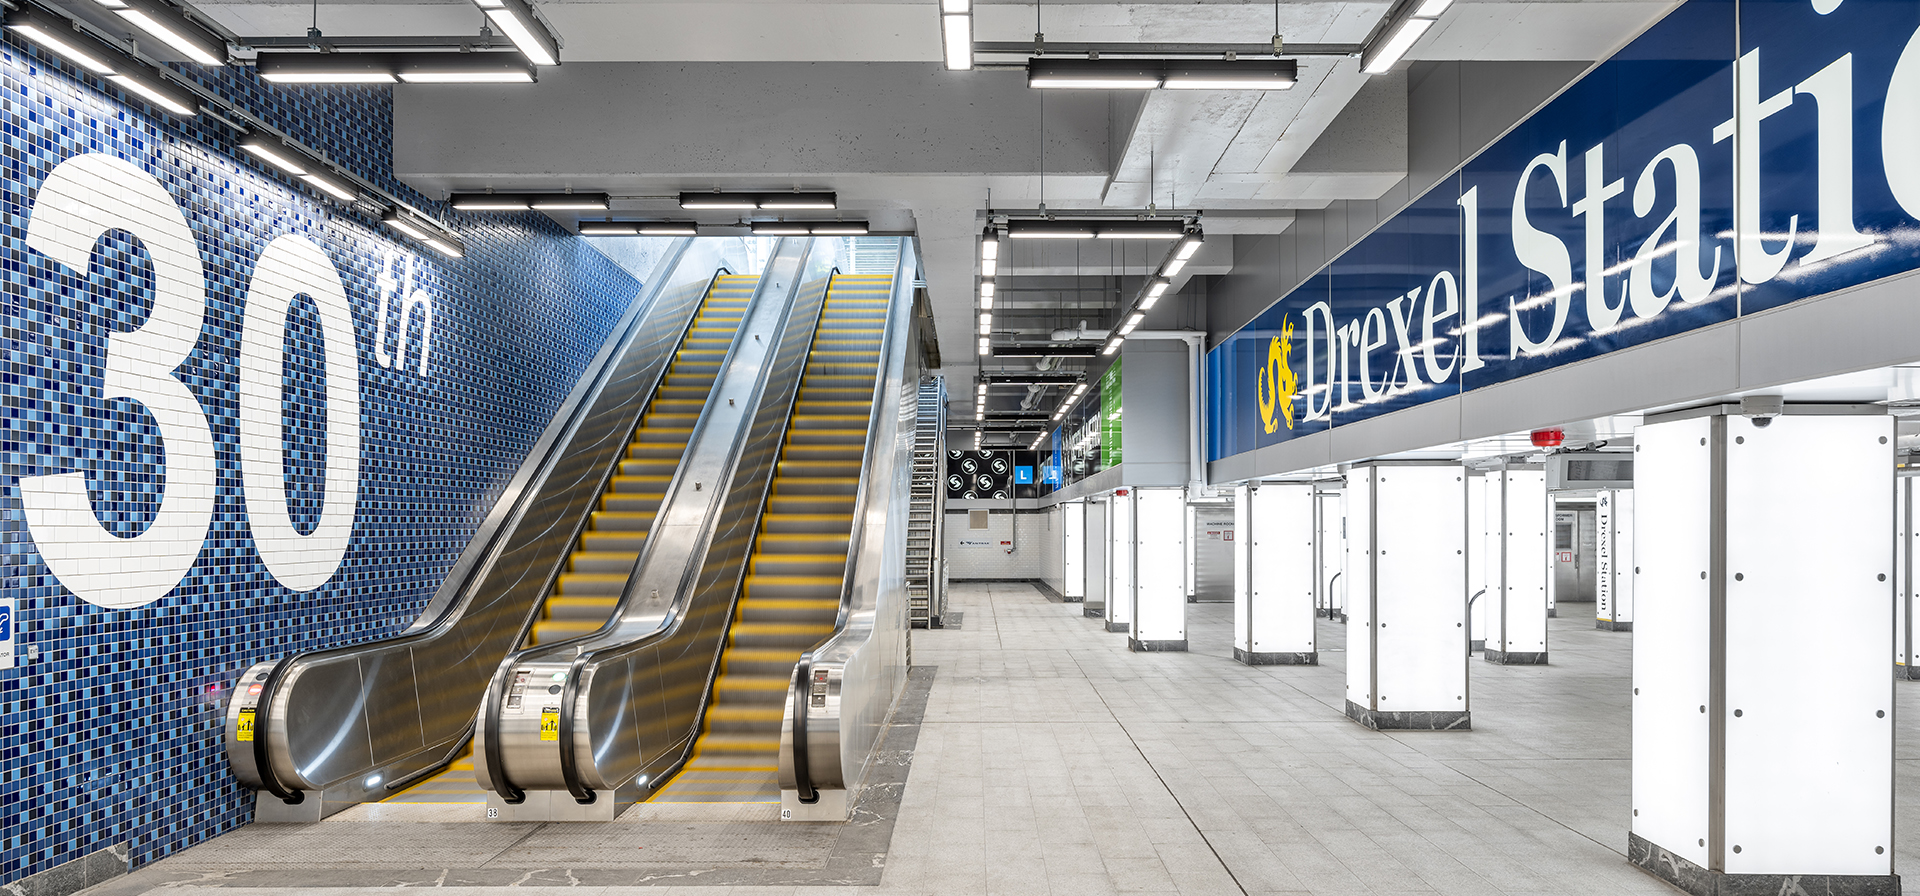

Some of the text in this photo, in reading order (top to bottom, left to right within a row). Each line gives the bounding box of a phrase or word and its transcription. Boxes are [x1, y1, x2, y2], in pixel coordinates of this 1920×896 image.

[1302, 185, 1487, 423] Drexel
[1020, 470, 1027, 480] L
[1600, 515, 1608, 611] Drexel Station
[488, 808, 498, 818] 38
[783, 810, 791, 818] 40
